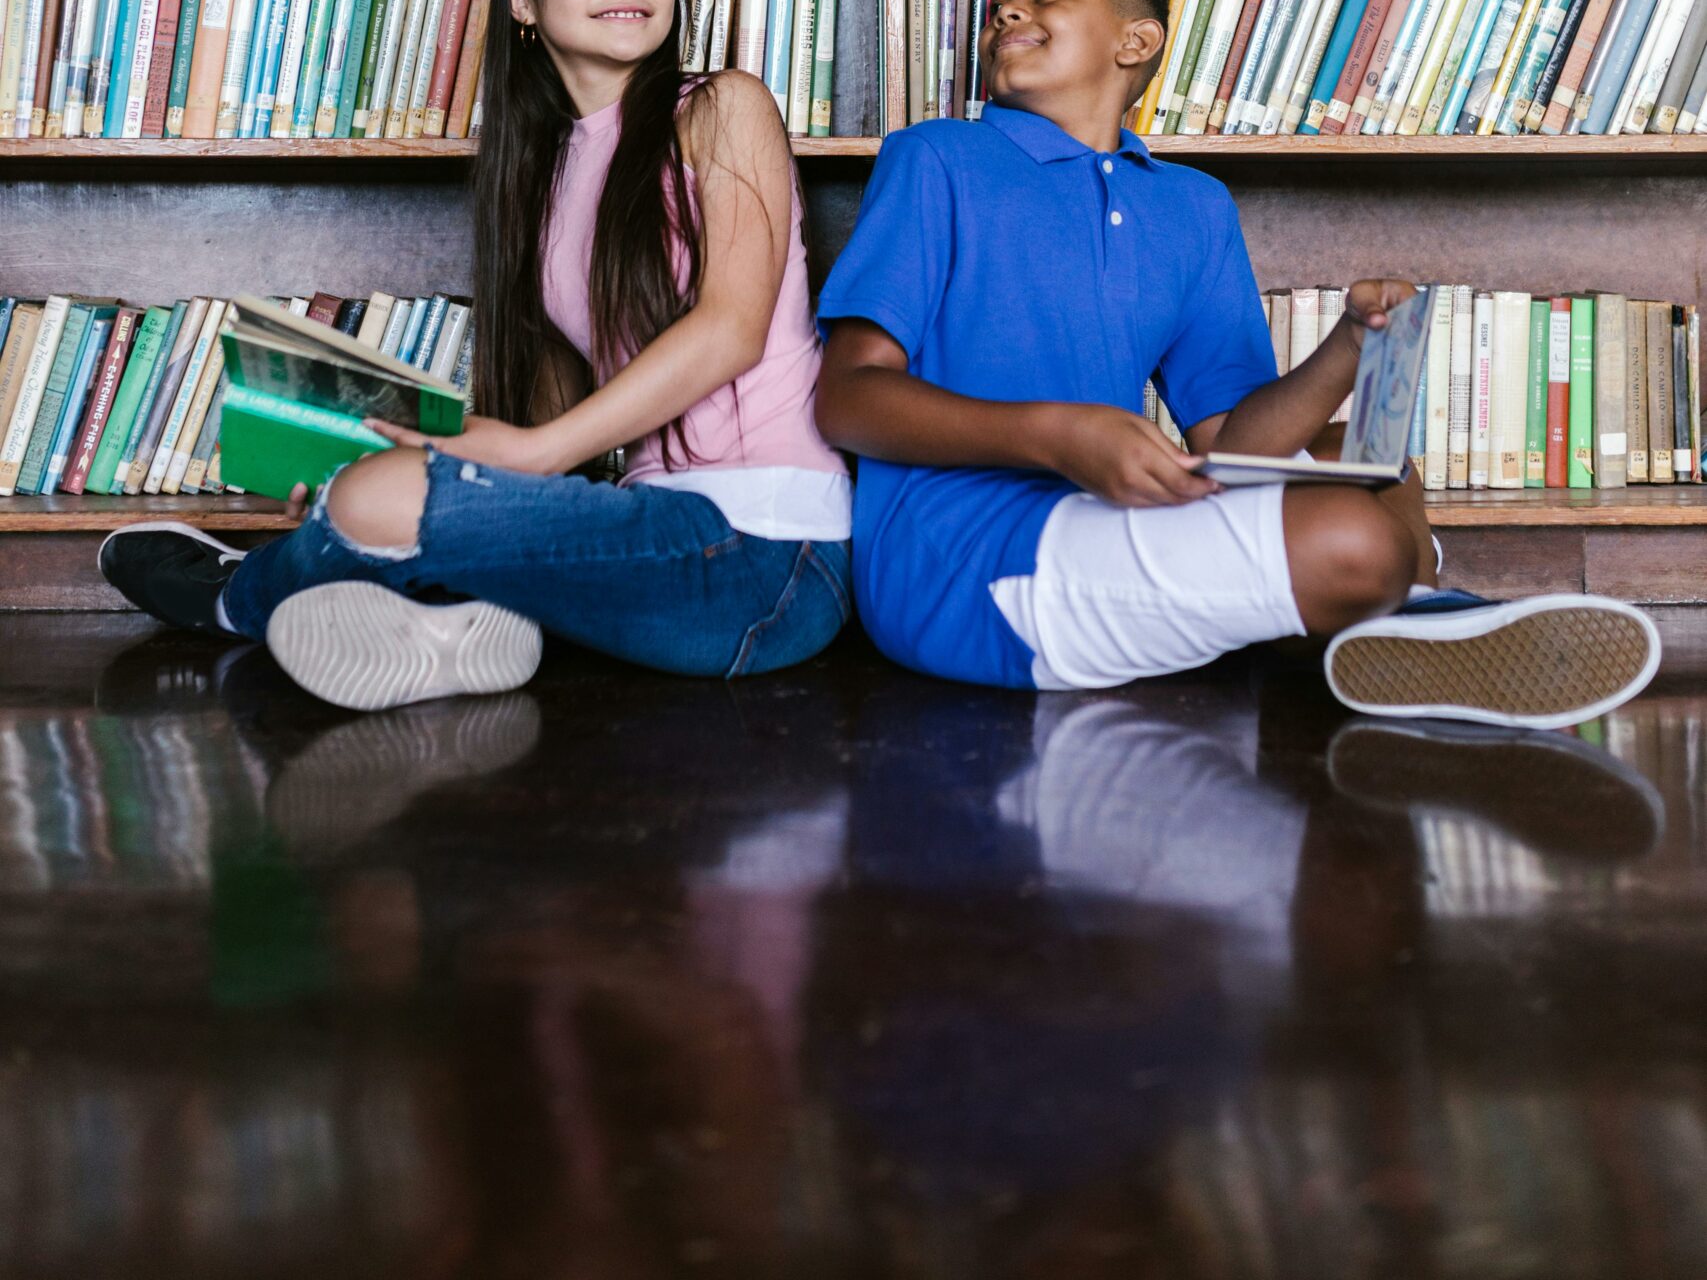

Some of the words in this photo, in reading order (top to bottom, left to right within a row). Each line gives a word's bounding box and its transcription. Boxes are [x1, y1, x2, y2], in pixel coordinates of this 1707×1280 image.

[139, 18, 151, 41] COOL
[182, 7, 195, 46] SUMMER
[802, 7, 815, 49] TIGERS
[1368, 6, 1382, 22] The
[444, 12, 458, 54] CARNIVAL
[690, 24, 700, 43] the
[1354, 22, 1376, 59] Hawaiian
[133, 44, 148, 80] PLASTIC
[1376, 39, 1391, 63] FIELD
[174, 58, 187, 93] Chickering
[1344, 60, 1360, 87] Sword
[116, 315, 132, 342] COLLINS
[92, 365, 117, 421] CATCHING
[1480, 357, 1489, 396] LIGHTNING
[1632, 371, 1640, 410] CAMILLO
[1658, 371, 1666, 410] CAMILLO
[1478, 399, 1487, 429] SLINGER
[83, 424, 98, 450] FIRE
